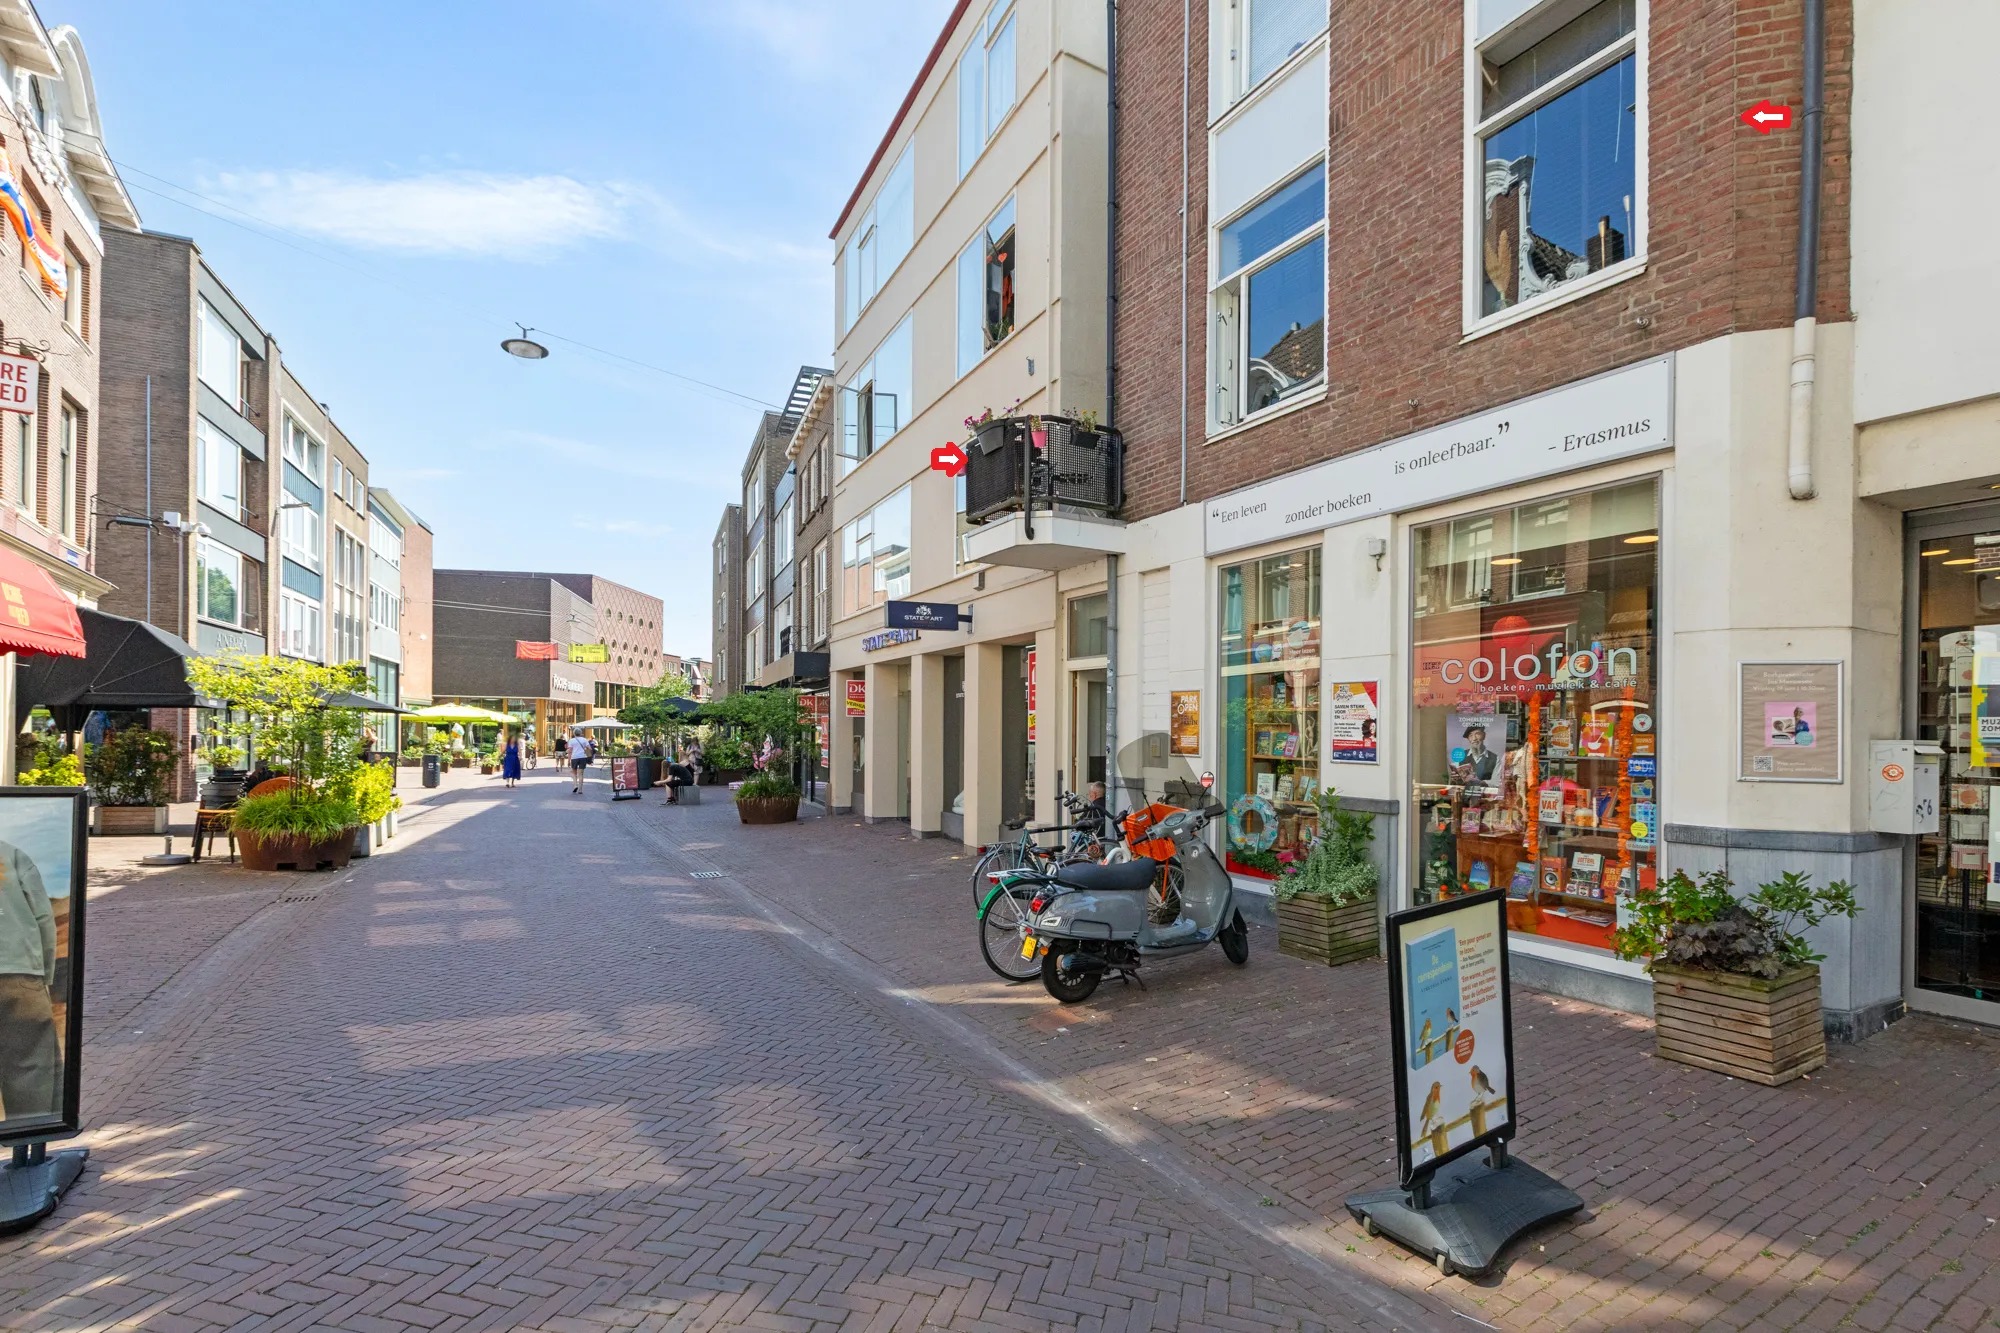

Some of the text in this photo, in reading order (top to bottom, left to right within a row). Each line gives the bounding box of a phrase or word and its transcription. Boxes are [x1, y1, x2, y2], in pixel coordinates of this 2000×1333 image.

[1563, 418, 1651, 452] Erasmus
[1394, 460, 1406, 475] is
[1240, 502, 1267, 517] leven
[1285, 492, 1372, 524] zonder boeken
[862, 633, 888, 652] STATE
[1441, 643, 1637, 684] colofon
[1480, 679, 1637, 693] boeken, muziek & café
[799, 698, 814, 706] DK
[1180, 695, 1198, 704] PARK
[1177, 703, 1198, 715] OPEN
[614, 758, 626, 790] SALE
